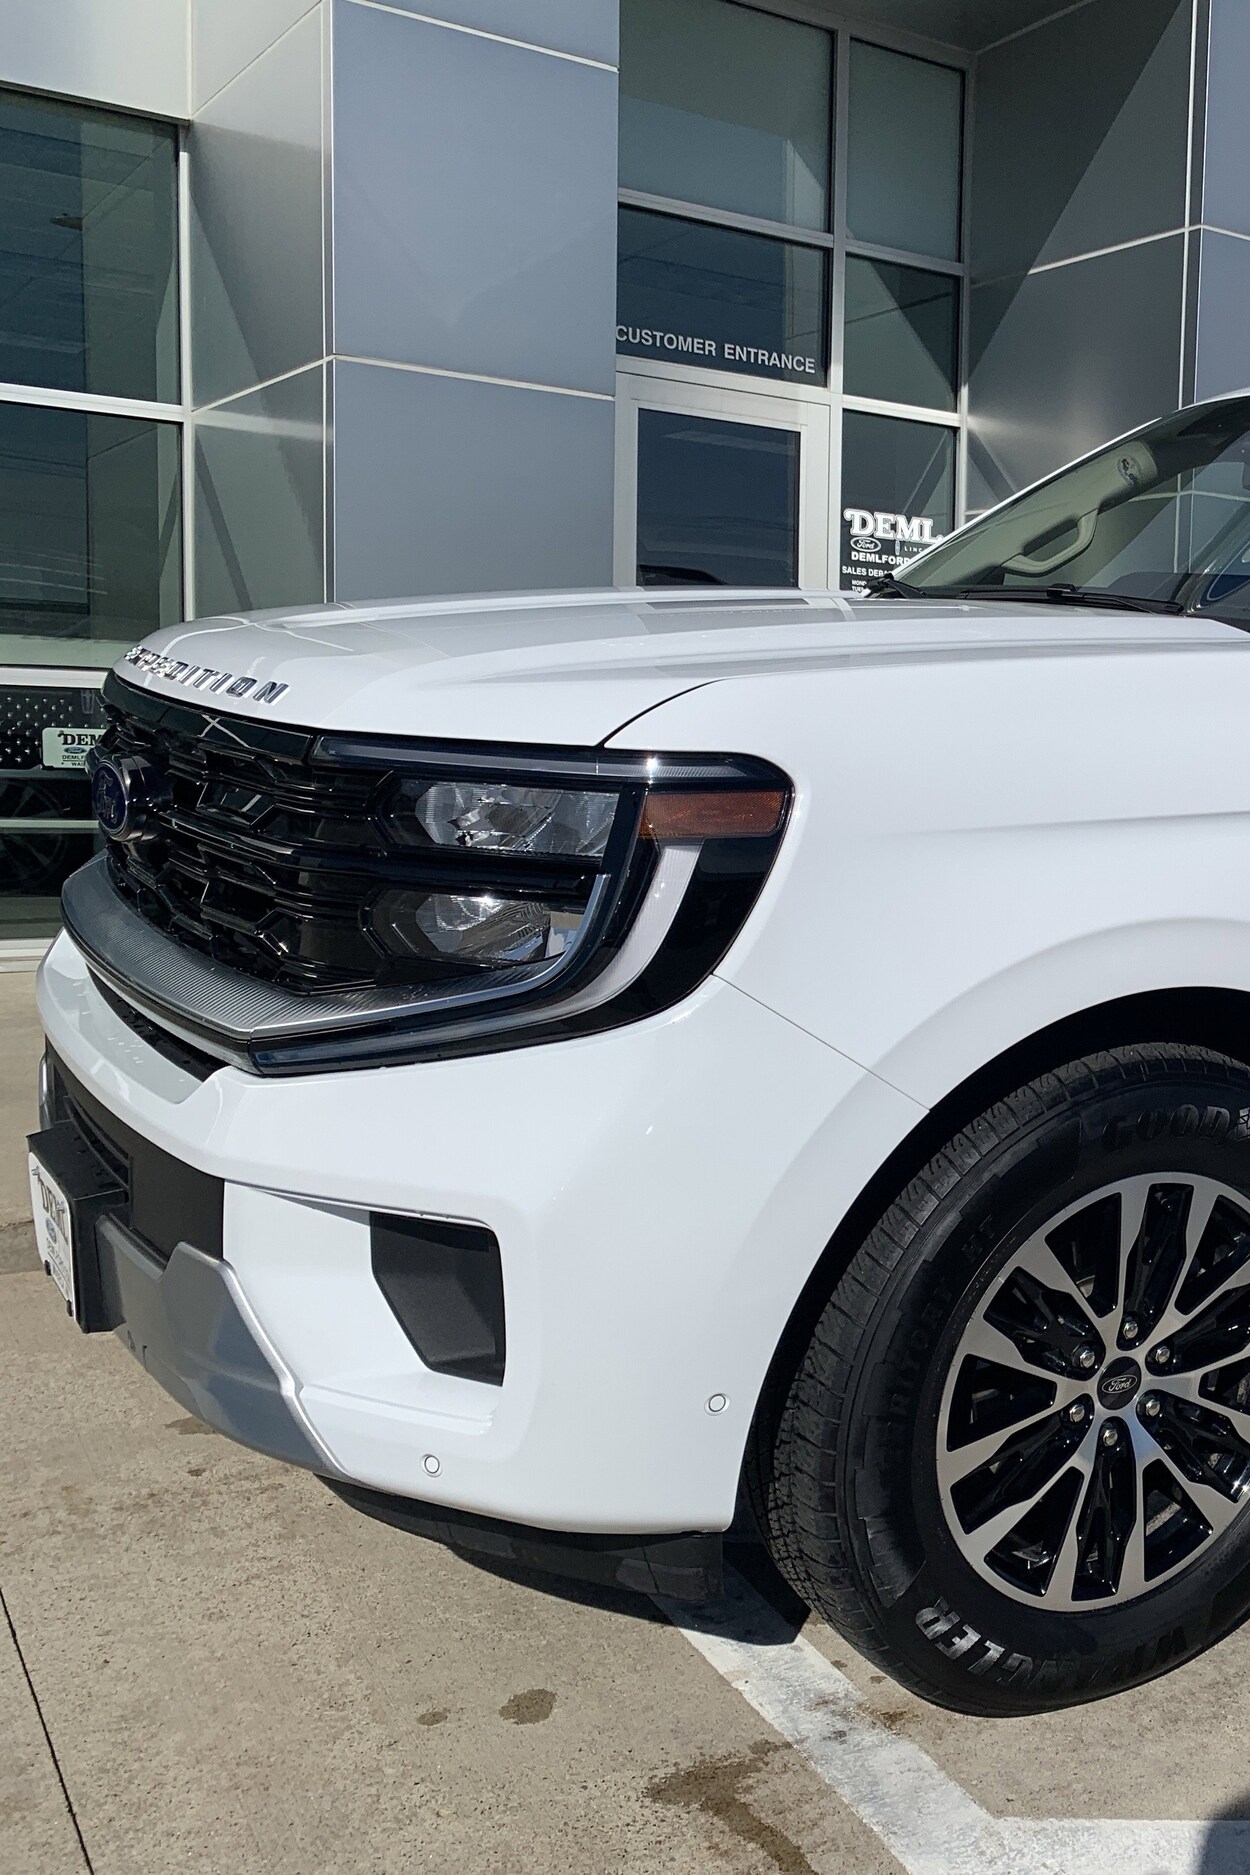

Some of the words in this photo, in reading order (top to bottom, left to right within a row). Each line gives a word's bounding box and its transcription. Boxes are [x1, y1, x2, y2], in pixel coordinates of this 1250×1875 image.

[616, 325, 716, 357] CUSTOMER
[724, 343, 816, 374] ENTRANCE
[843, 508, 944, 545] DEML
[856, 539, 876, 550] Ford
[842, 565, 867, 576] SALES
[1108, 1377, 1132, 1392] Ford
